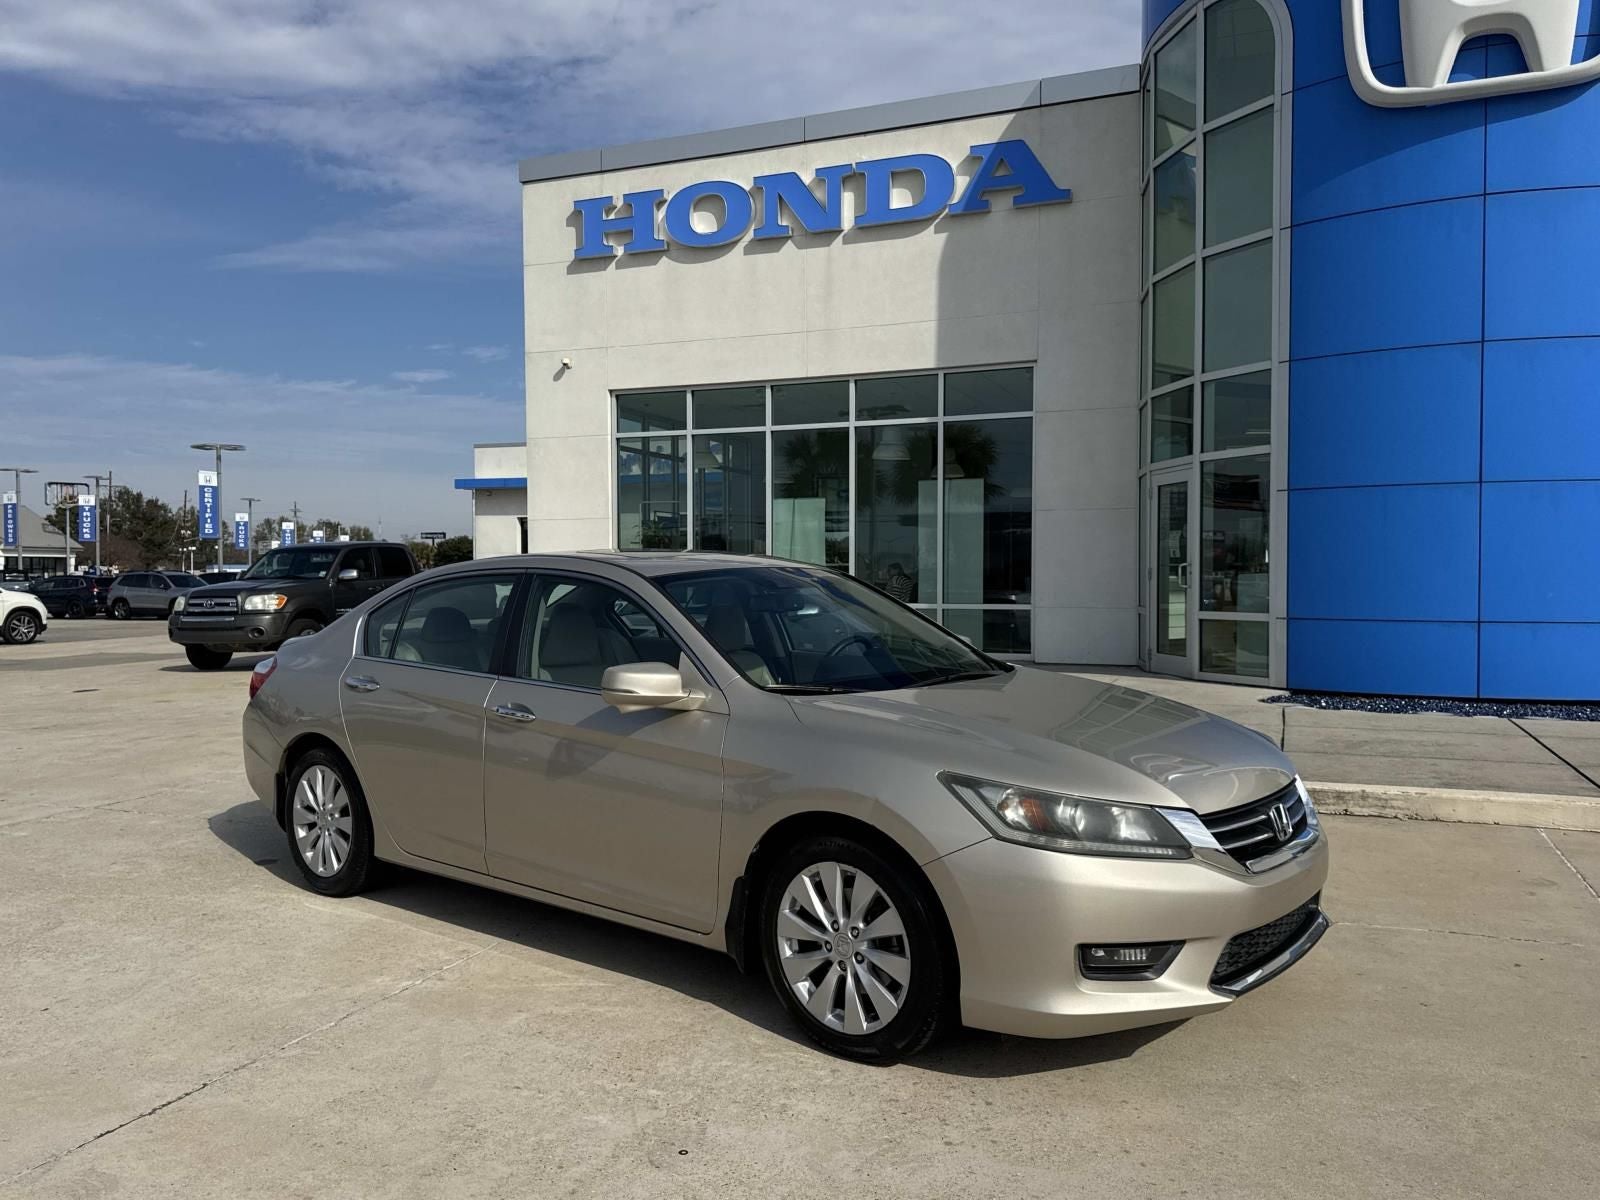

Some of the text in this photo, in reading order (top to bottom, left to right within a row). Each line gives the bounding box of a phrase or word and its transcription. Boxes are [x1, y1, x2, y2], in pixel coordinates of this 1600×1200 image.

[573, 139, 1073, 260] HONDA
[82, 506, 91, 539] TRUCKS
[203, 487, 213, 534] CERTIFIED
